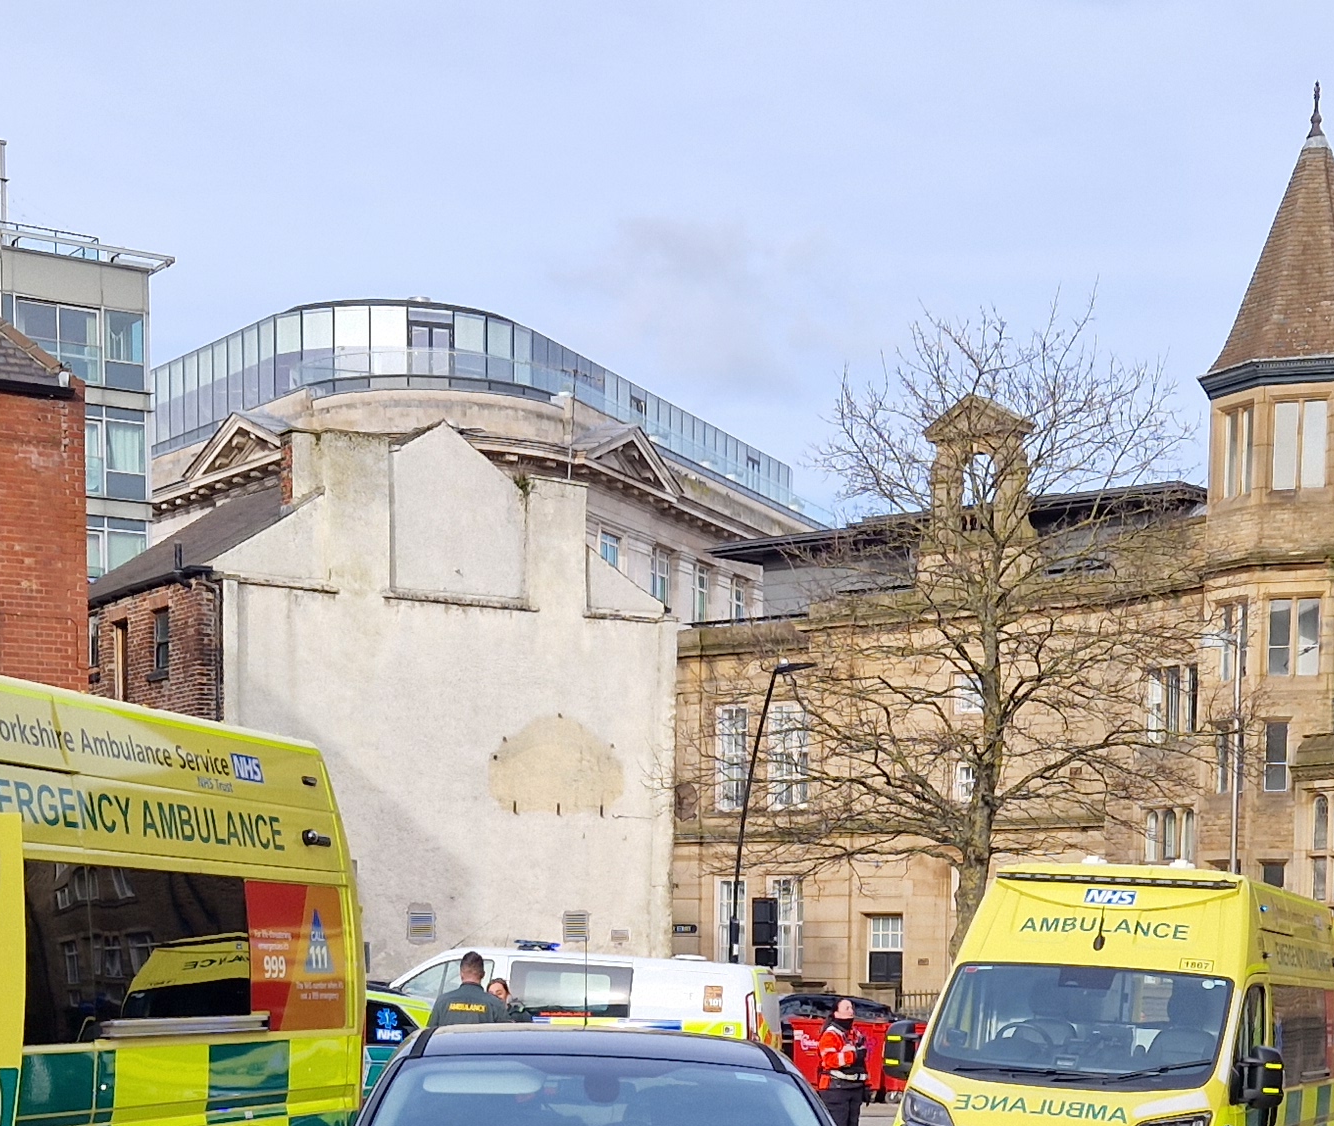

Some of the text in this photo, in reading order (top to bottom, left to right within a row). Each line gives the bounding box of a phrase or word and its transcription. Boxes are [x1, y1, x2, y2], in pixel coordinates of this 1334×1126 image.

[81, 728, 173, 768] Ambulance
[175, 745, 230, 776] Service
[231, 754, 263, 781] NHS
[197, 776, 234, 793] NHS Trust
[142, 800, 286, 851] AMBULANCE
[1084, 889, 1137, 905] NHS
[311, 931, 325, 941] CALL
[1019, 916, 1191, 941] AMBULANCE
[263, 955, 287, 978] 999
[309, 945, 327, 969] 111
[448, 1003, 487, 1013] AMBULANCE
[377, 1030, 402, 1041] NHS
